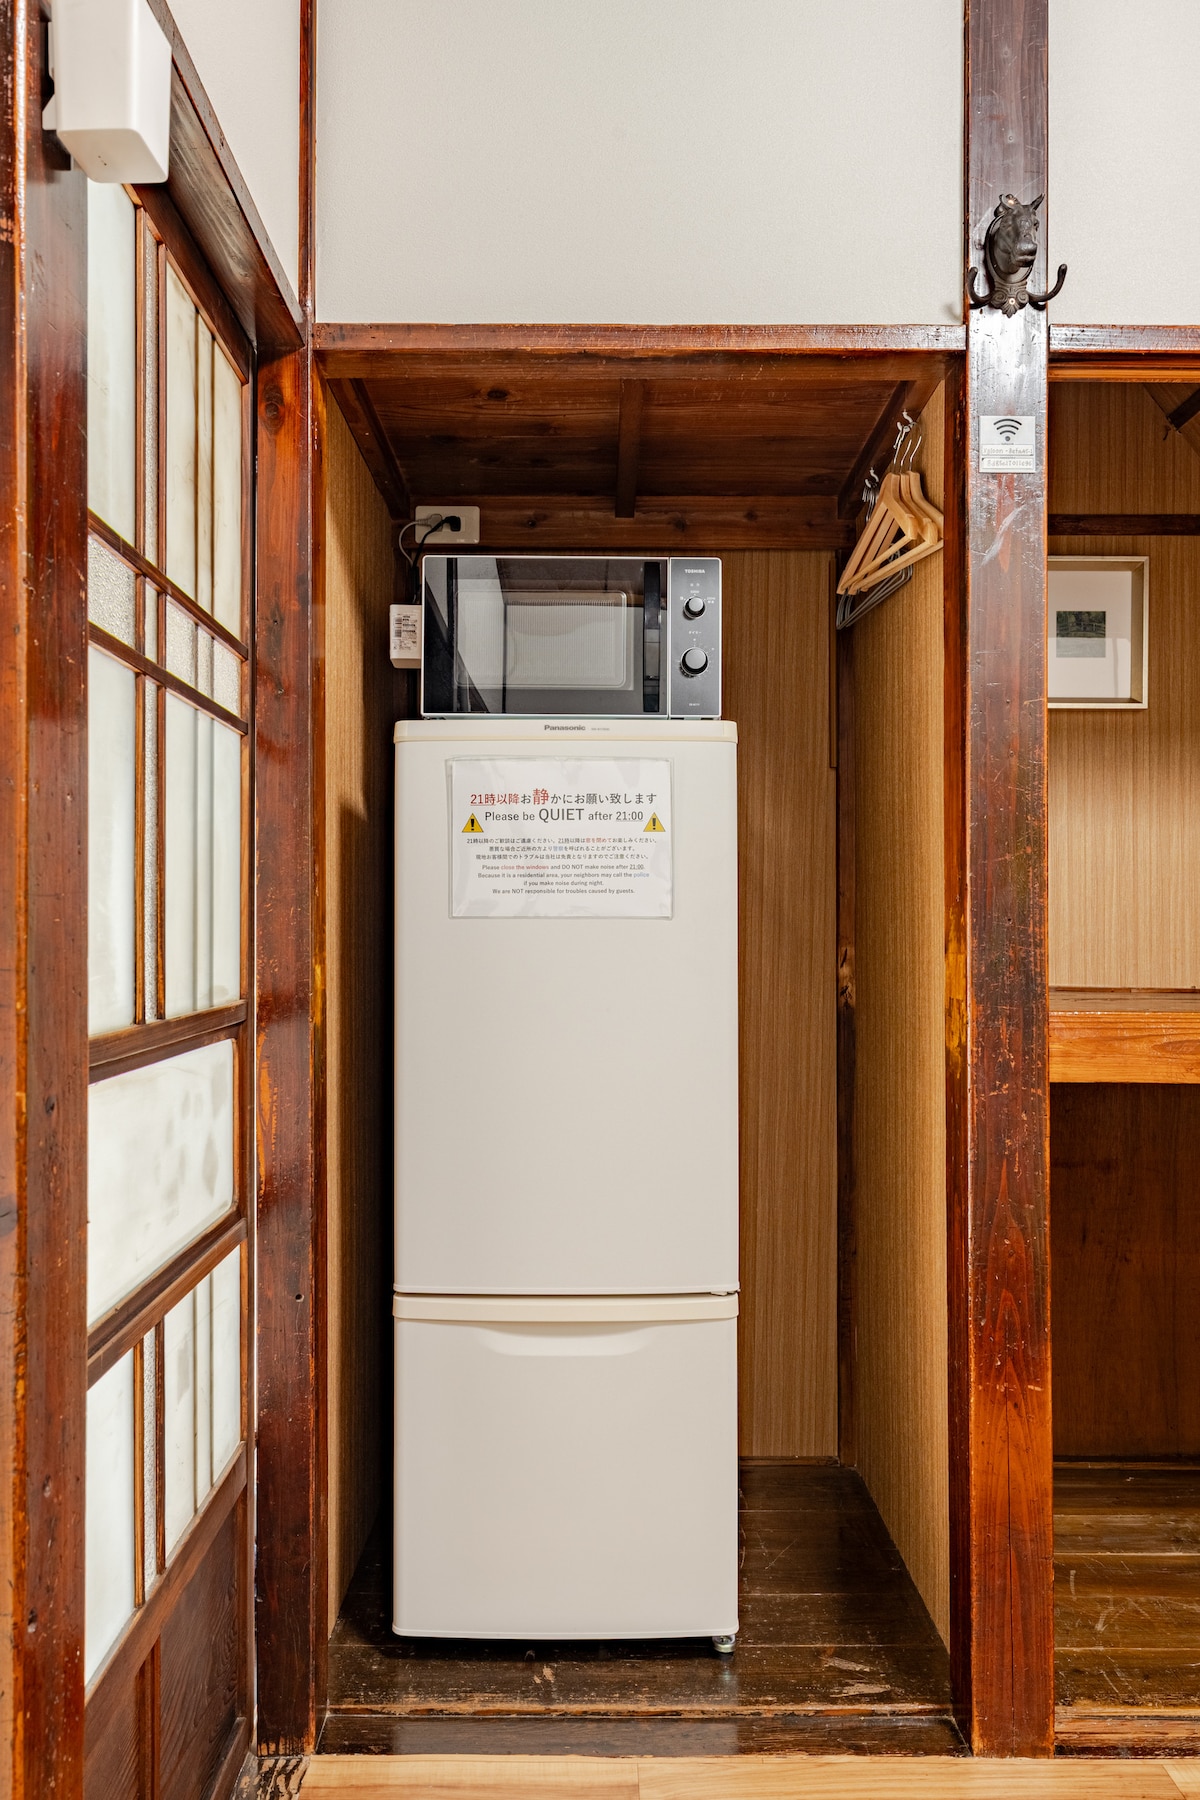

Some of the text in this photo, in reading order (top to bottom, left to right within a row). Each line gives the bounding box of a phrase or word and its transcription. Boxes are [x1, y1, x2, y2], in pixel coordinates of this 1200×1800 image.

[470, 788, 657, 806] 21時以降お静かにお願い致します
[485, 808, 644, 823] Please be QUIET after 21:00
